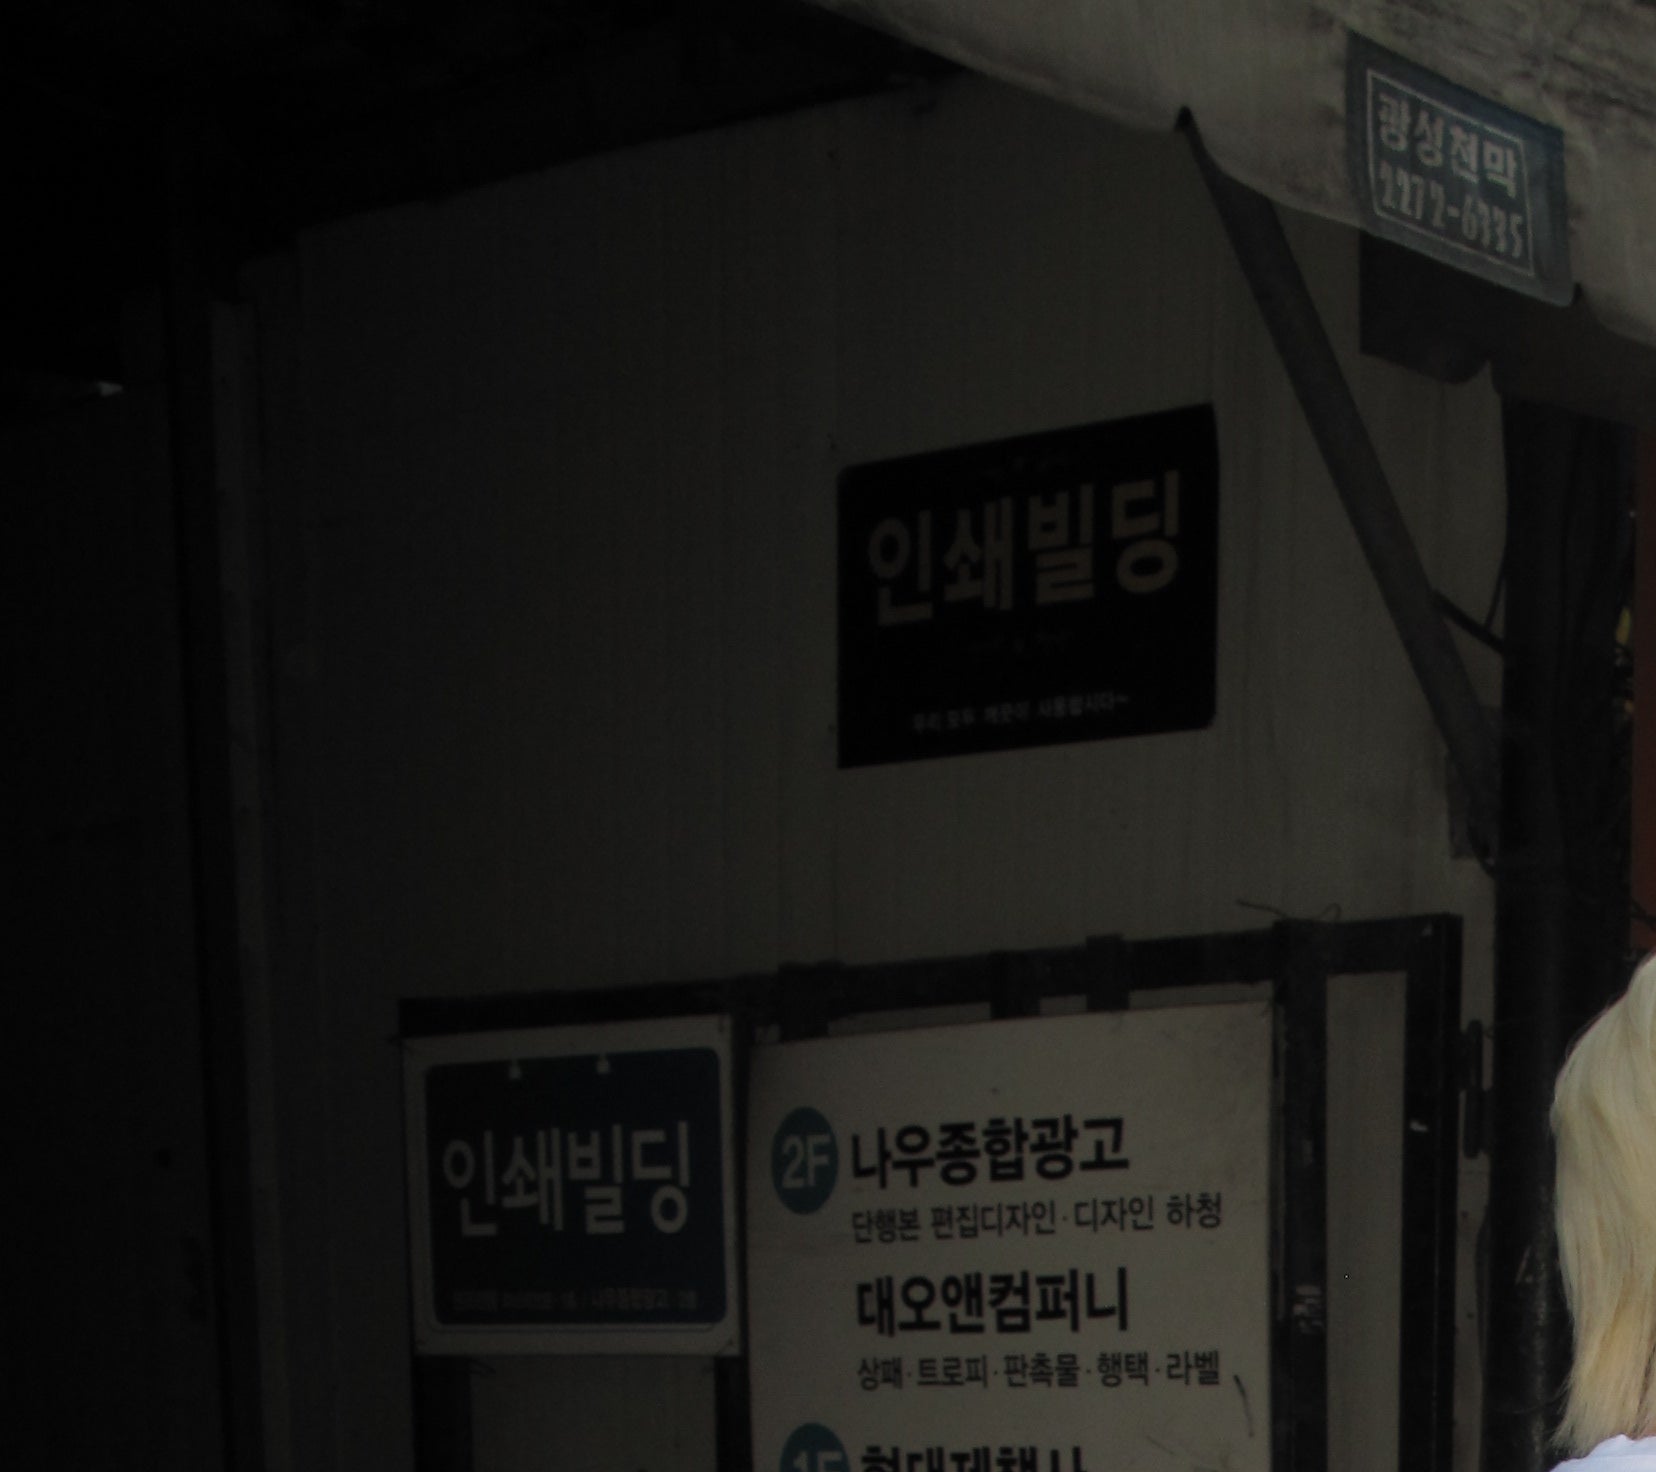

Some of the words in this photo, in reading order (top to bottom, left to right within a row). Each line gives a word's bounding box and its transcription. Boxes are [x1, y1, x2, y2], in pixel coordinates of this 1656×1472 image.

[867, 468, 1180, 628] 인쇄빌딩
[442, 1120, 691, 1238] 인쇄빌딩
[780, 1132, 831, 1190] 2F
[852, 1114, 1130, 1190] 나우종합광고
[851, 1207, 920, 1244] 단행본
[1166, 1192, 1222, 1230] 하청
[856, 1266, 1128, 1337] 대오앤컴퍼니
